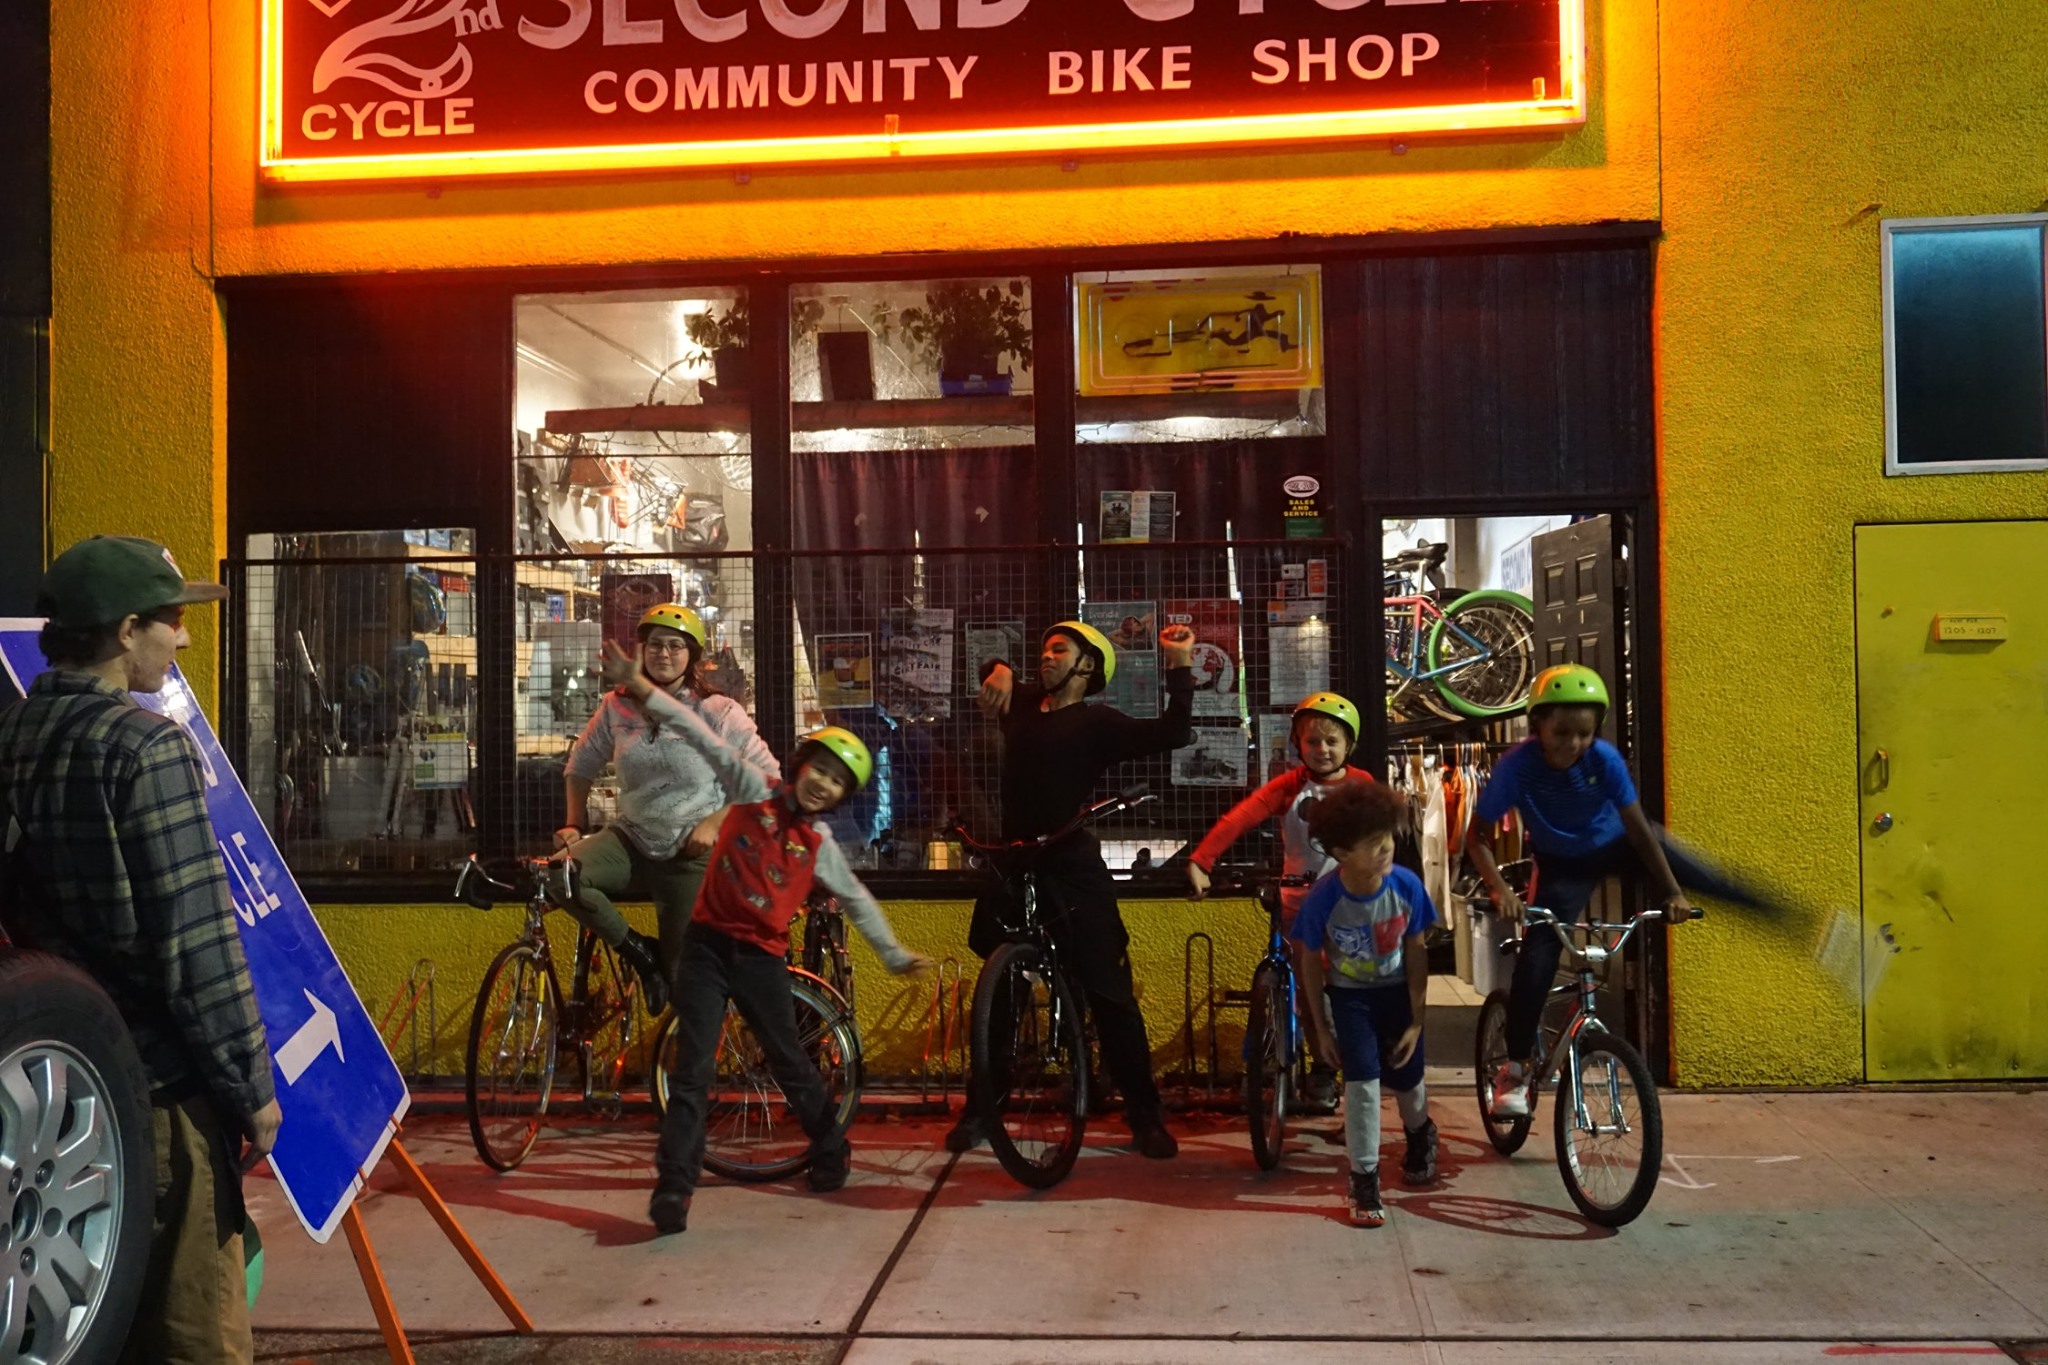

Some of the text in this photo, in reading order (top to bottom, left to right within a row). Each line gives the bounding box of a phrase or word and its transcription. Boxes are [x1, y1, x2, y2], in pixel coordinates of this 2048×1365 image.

[584, 33, 1440, 114] COMMUNITY BIKE SHOP
[301, 98, 475, 140] CYCLE
[1167, 614, 1193, 624] TED
[917, 662, 941, 671] FAIR
